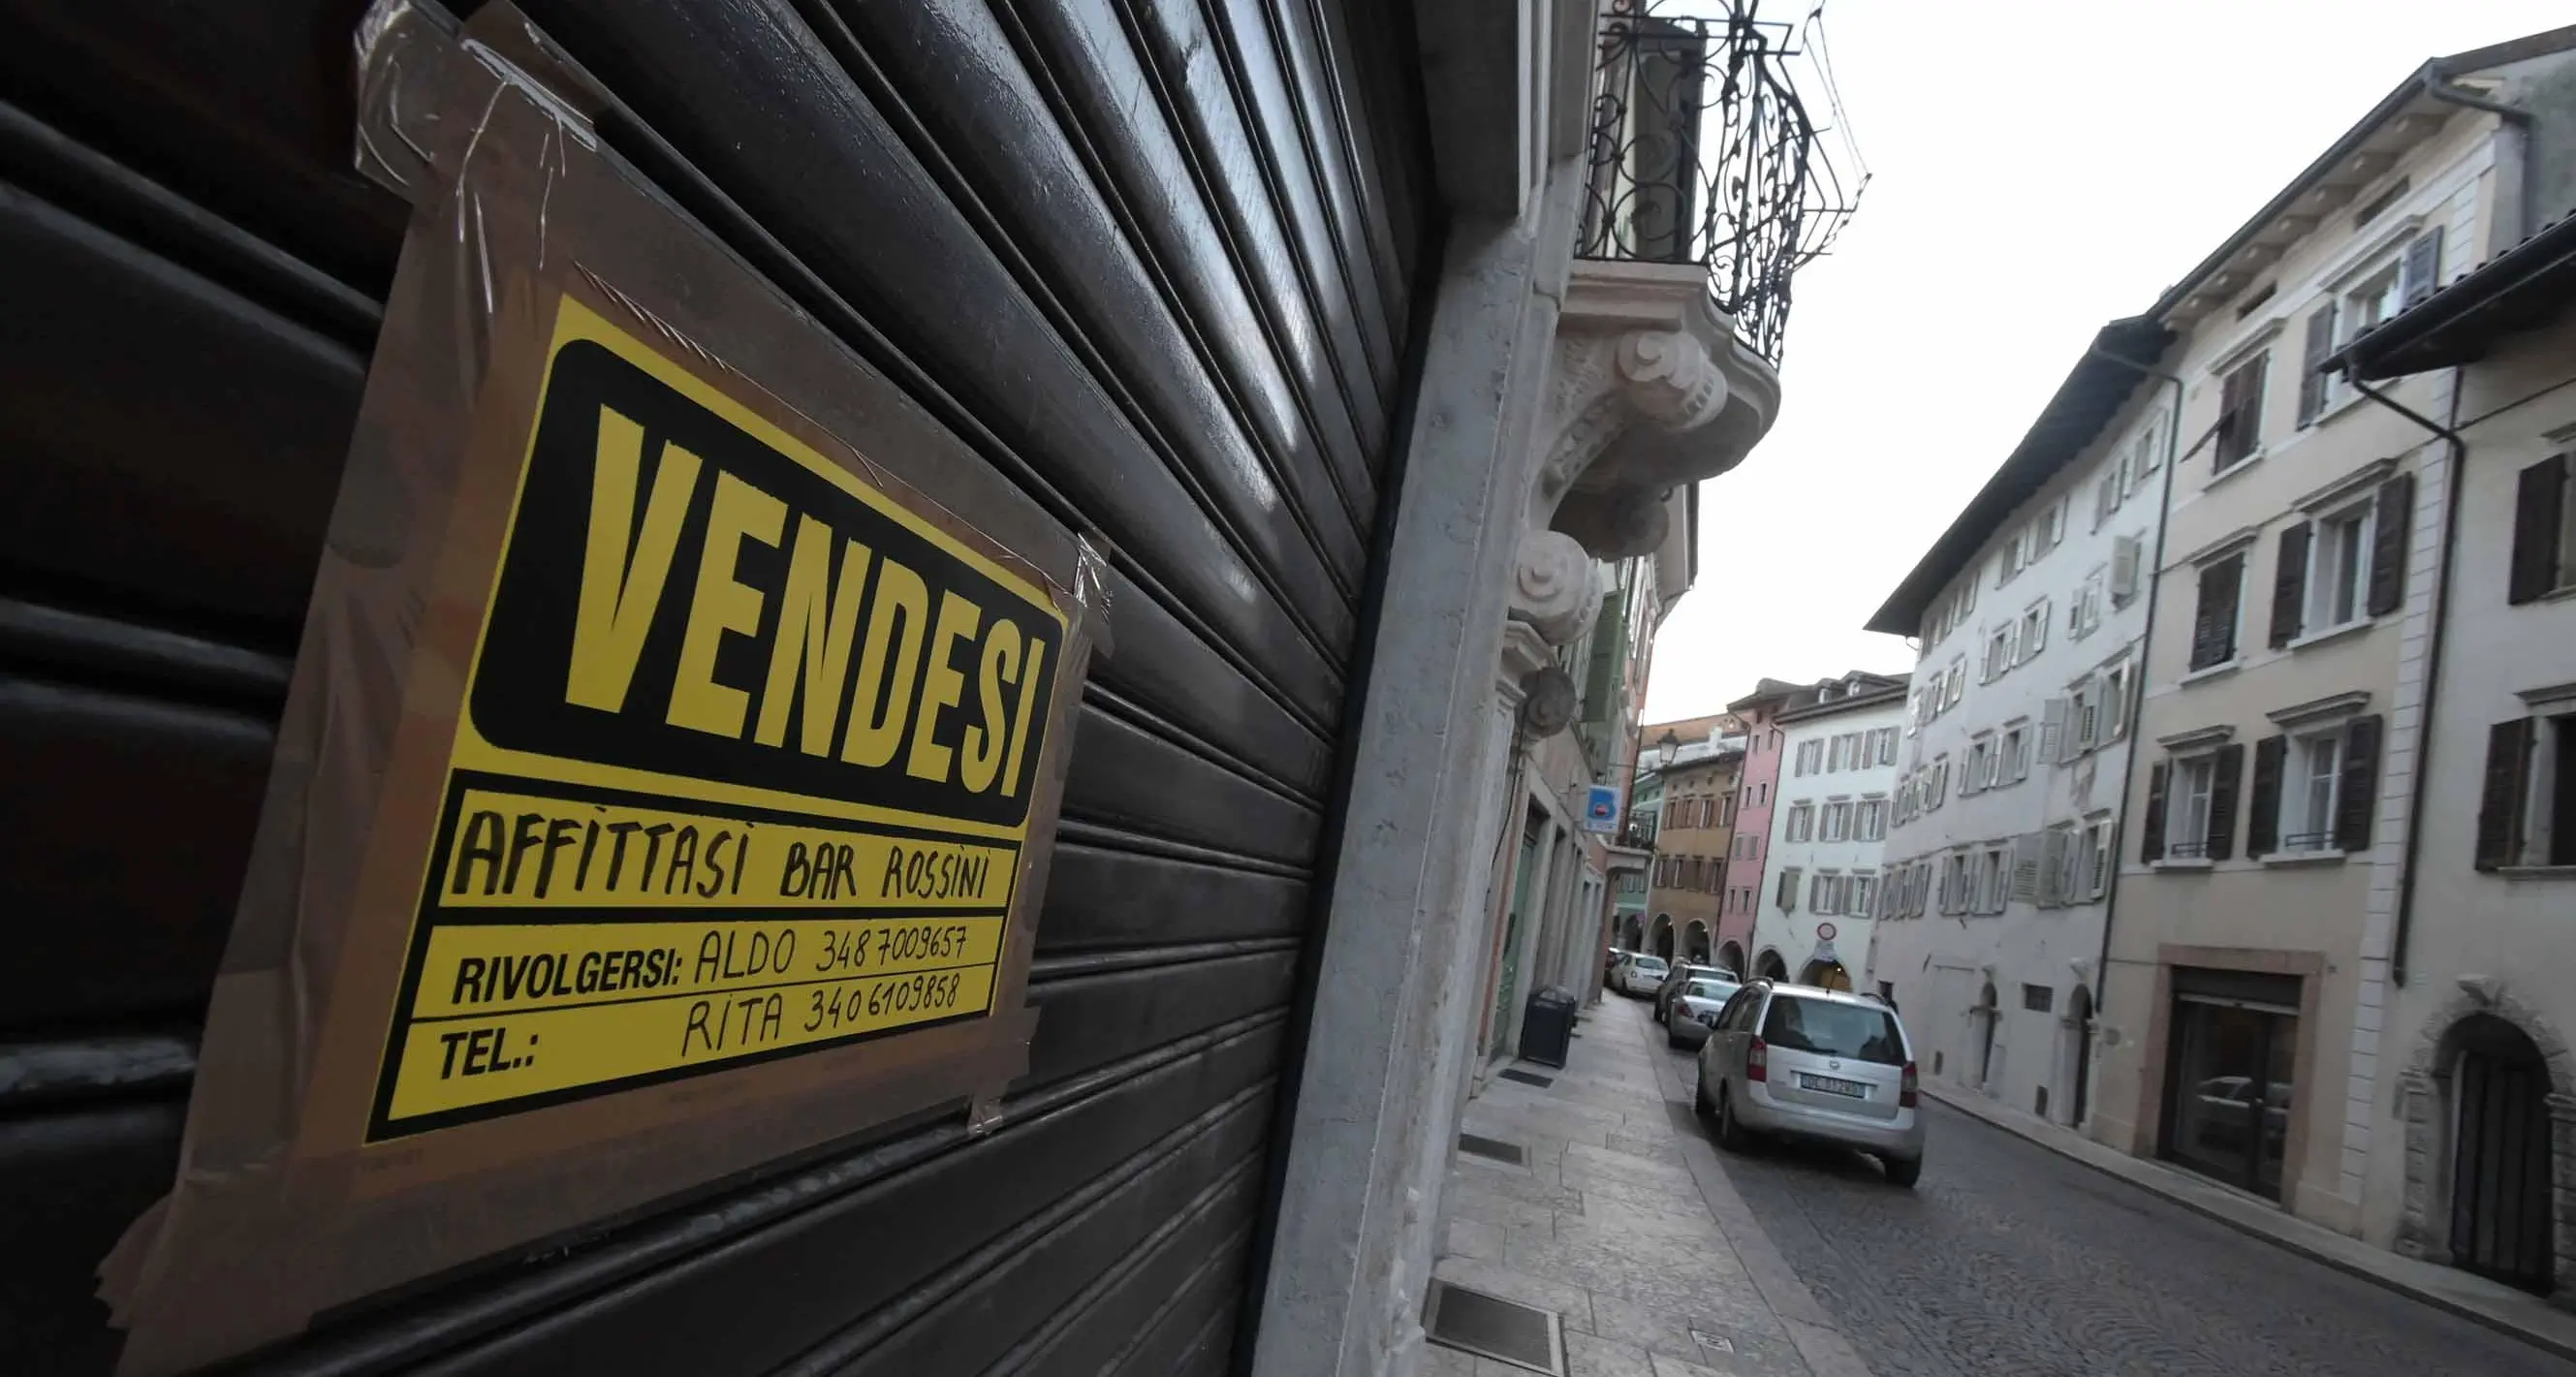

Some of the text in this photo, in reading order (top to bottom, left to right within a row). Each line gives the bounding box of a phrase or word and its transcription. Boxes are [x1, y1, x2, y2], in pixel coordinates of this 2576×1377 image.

[565, 402, 1046, 798] VENDESI
[779, 841, 857, 900] BAR
[452, 948, 682, 1005] RIVOLGERSI:
[694, 928, 796, 984] ALDO
[440, 1027, 538, 1080] TEL.:
[681, 992, 783, 1057] RITA
